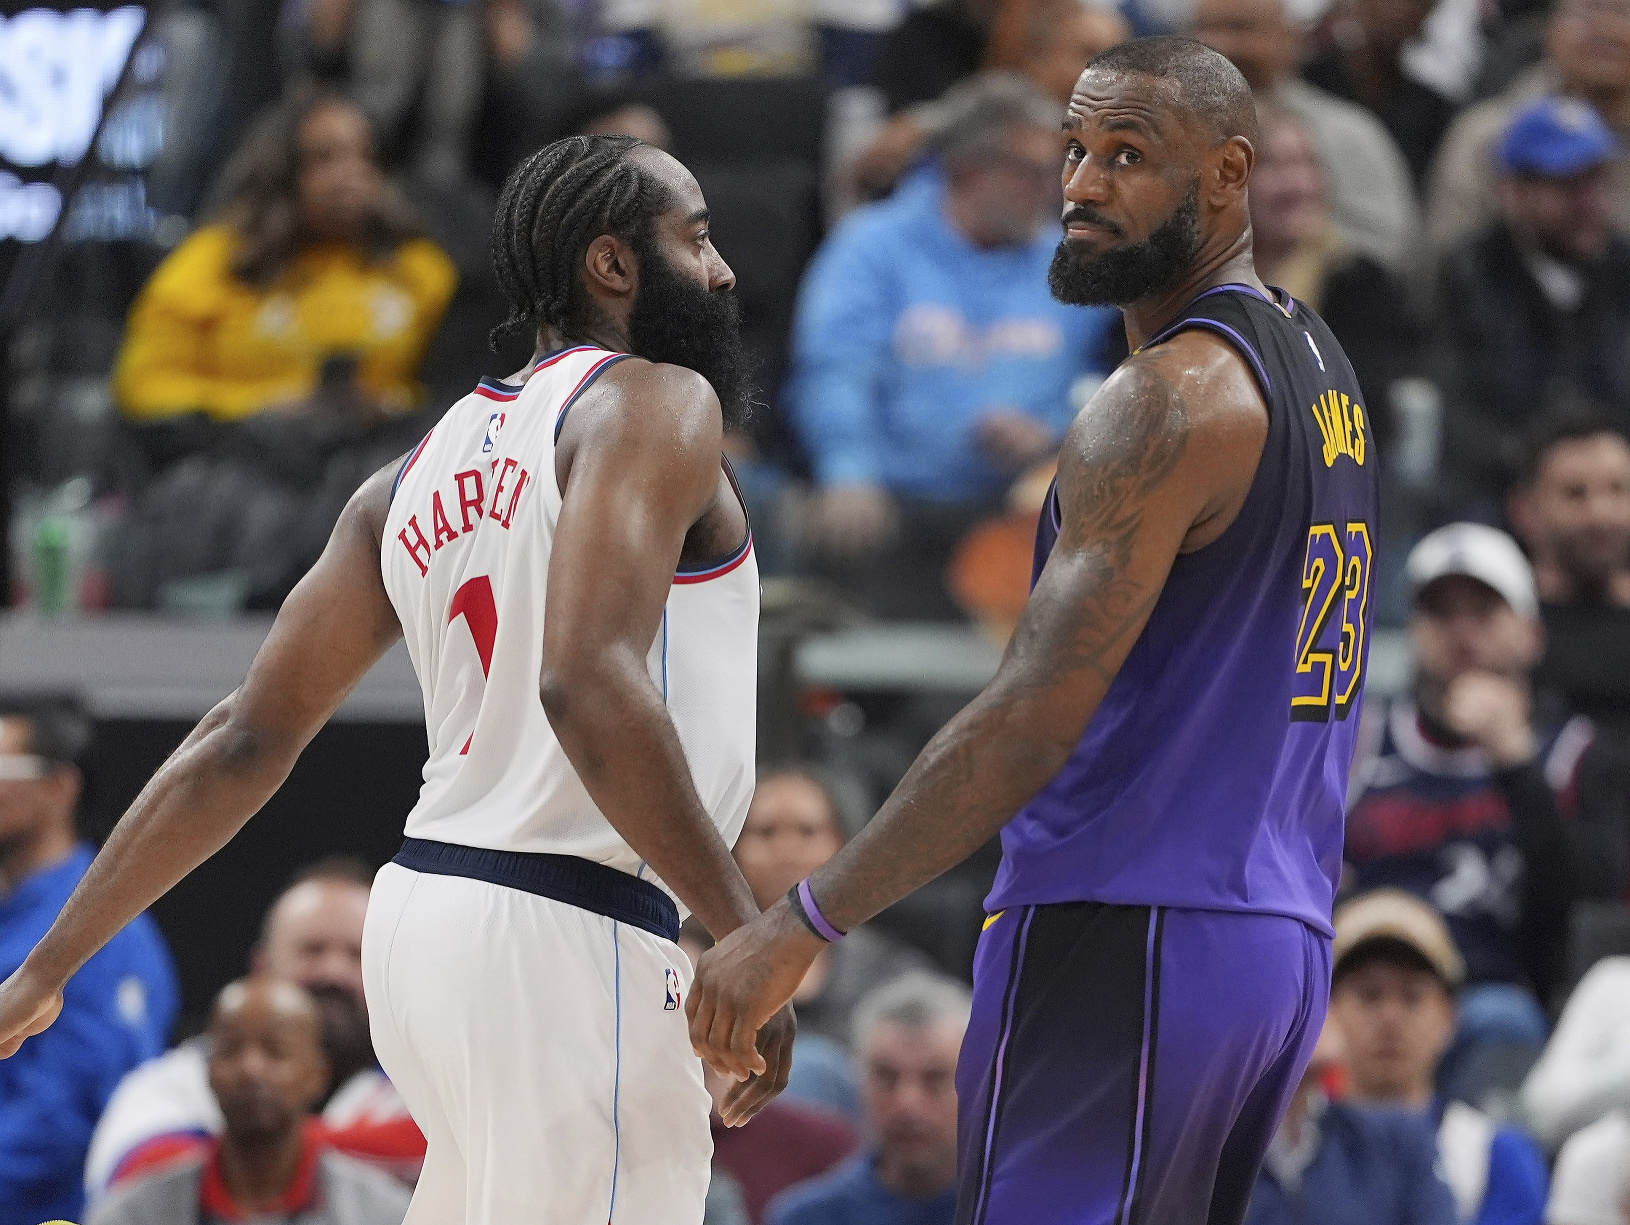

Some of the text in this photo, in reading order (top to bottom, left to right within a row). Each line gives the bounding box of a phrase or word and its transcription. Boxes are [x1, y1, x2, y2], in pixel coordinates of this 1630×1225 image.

[1311, 389, 1365, 468] JAMES
[398, 457, 531, 578] HAREN
[1291, 520, 1373, 718] 23
